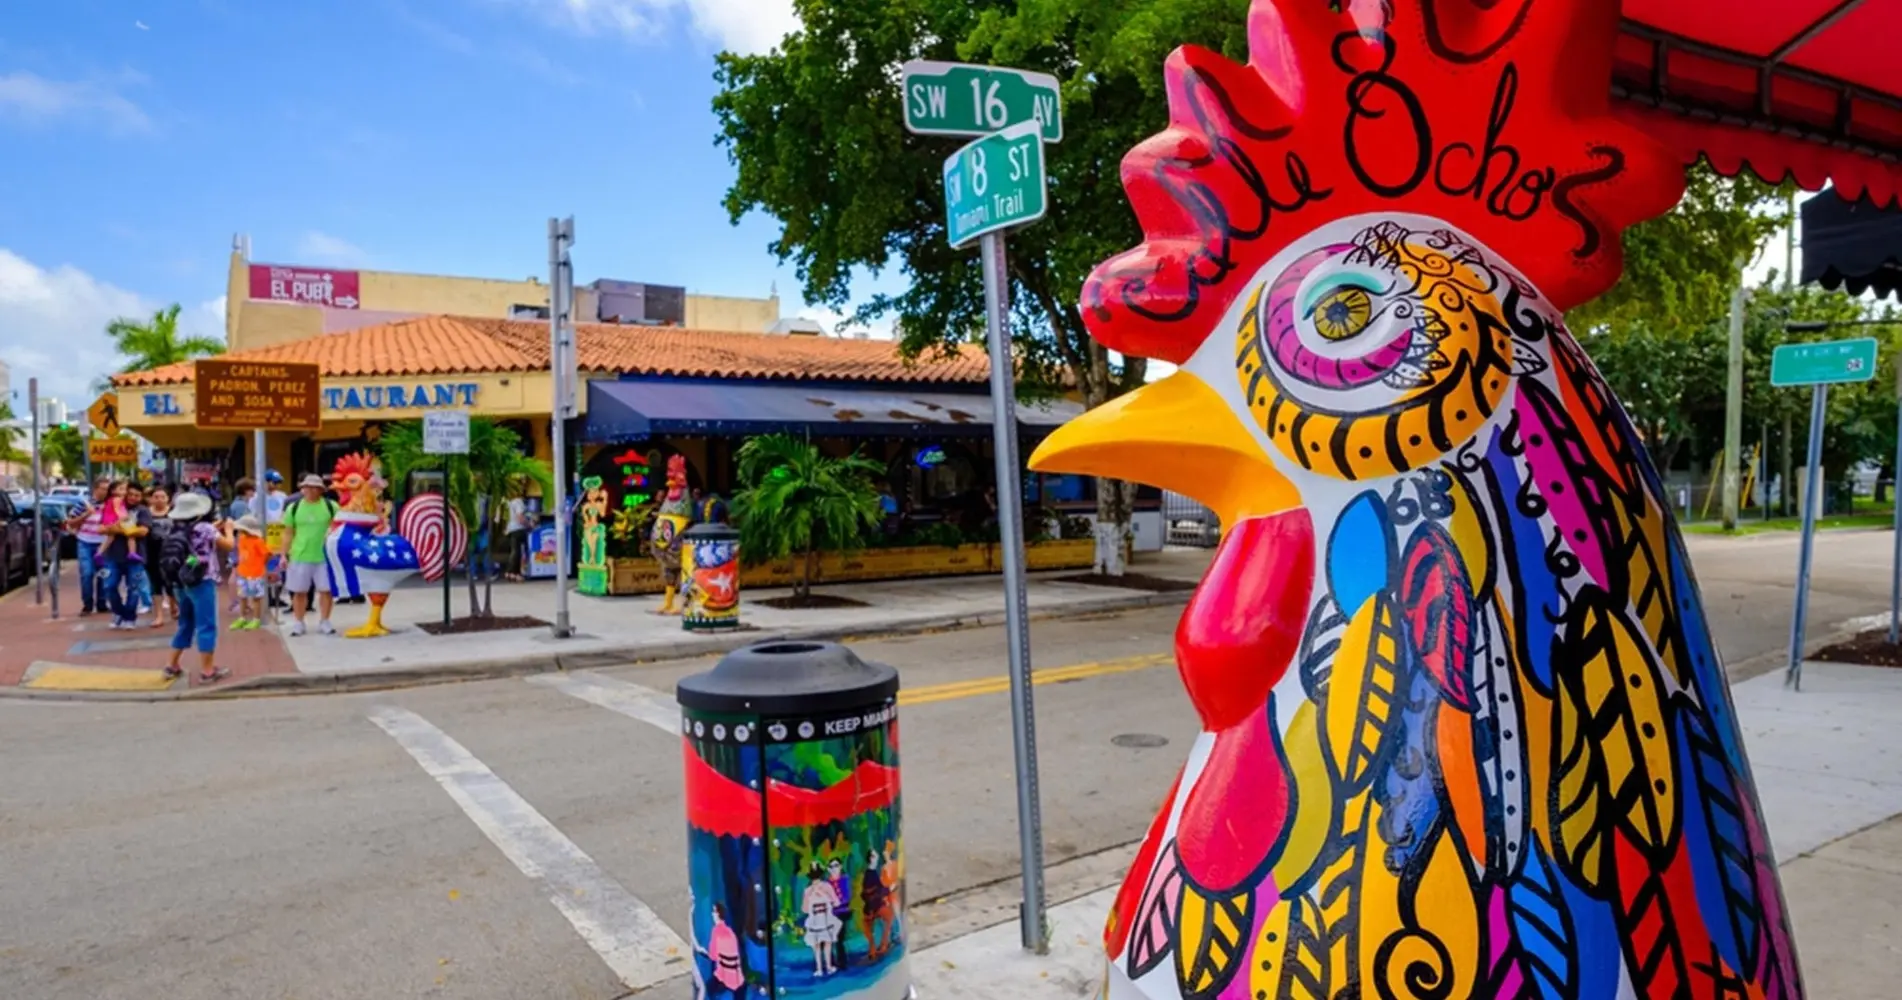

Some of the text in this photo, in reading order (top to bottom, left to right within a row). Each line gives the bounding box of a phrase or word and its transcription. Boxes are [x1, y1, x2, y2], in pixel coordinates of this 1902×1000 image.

[911, 77, 1053, 128] SW 16 AV
[971, 146, 988, 198] 8
[1008, 142, 1031, 181] ST
[993, 187, 1024, 219] Trail
[142, 383, 478, 416] EL TAURANT
[269, 381, 306, 393] PEREZ
[211, 395, 306, 408] AND SOSA WAY
[91, 444, 134, 456] AHEAD
[825, 716, 861, 736] KEEP
